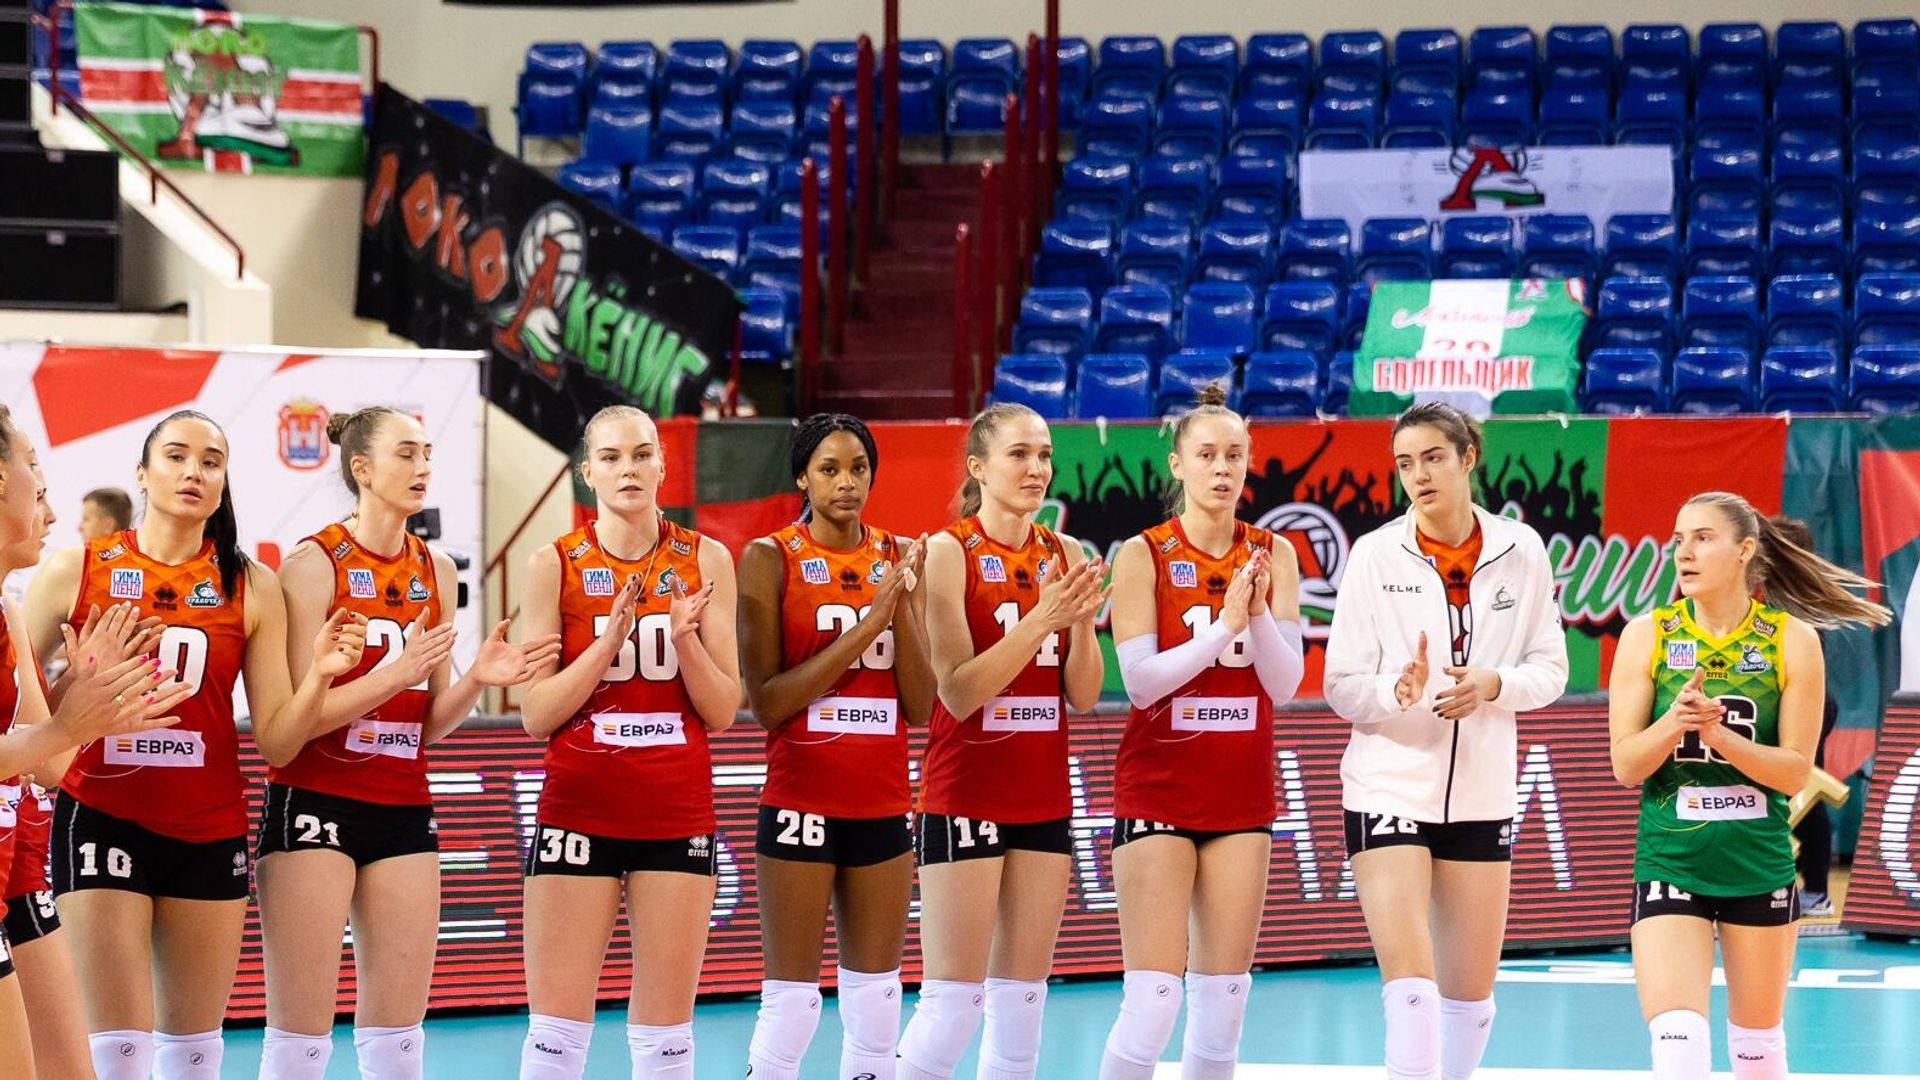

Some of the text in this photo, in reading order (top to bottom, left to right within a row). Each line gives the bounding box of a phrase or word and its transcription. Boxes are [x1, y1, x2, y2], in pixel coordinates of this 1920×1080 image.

[1375, 359, 1531, 393] БОЛЕЛЬЩИК
[1382, 584, 1422, 594] KELME
[837, 709, 888, 723] ЕВРАЗ
[1010, 707, 1056, 720] ЕВРАЗ
[1197, 708, 1249, 721] ЕВРАЗ
[620, 723, 674, 737] ЕВРАЗ
[136, 739, 194, 755] ЕВРАЗ
[1702, 795, 1756, 809] ЕВРАЗ
[294, 813, 341, 847] 21
[776, 809, 826, 847] 26
[953, 816, 998, 848] 14
[539, 828, 591, 866] 30
